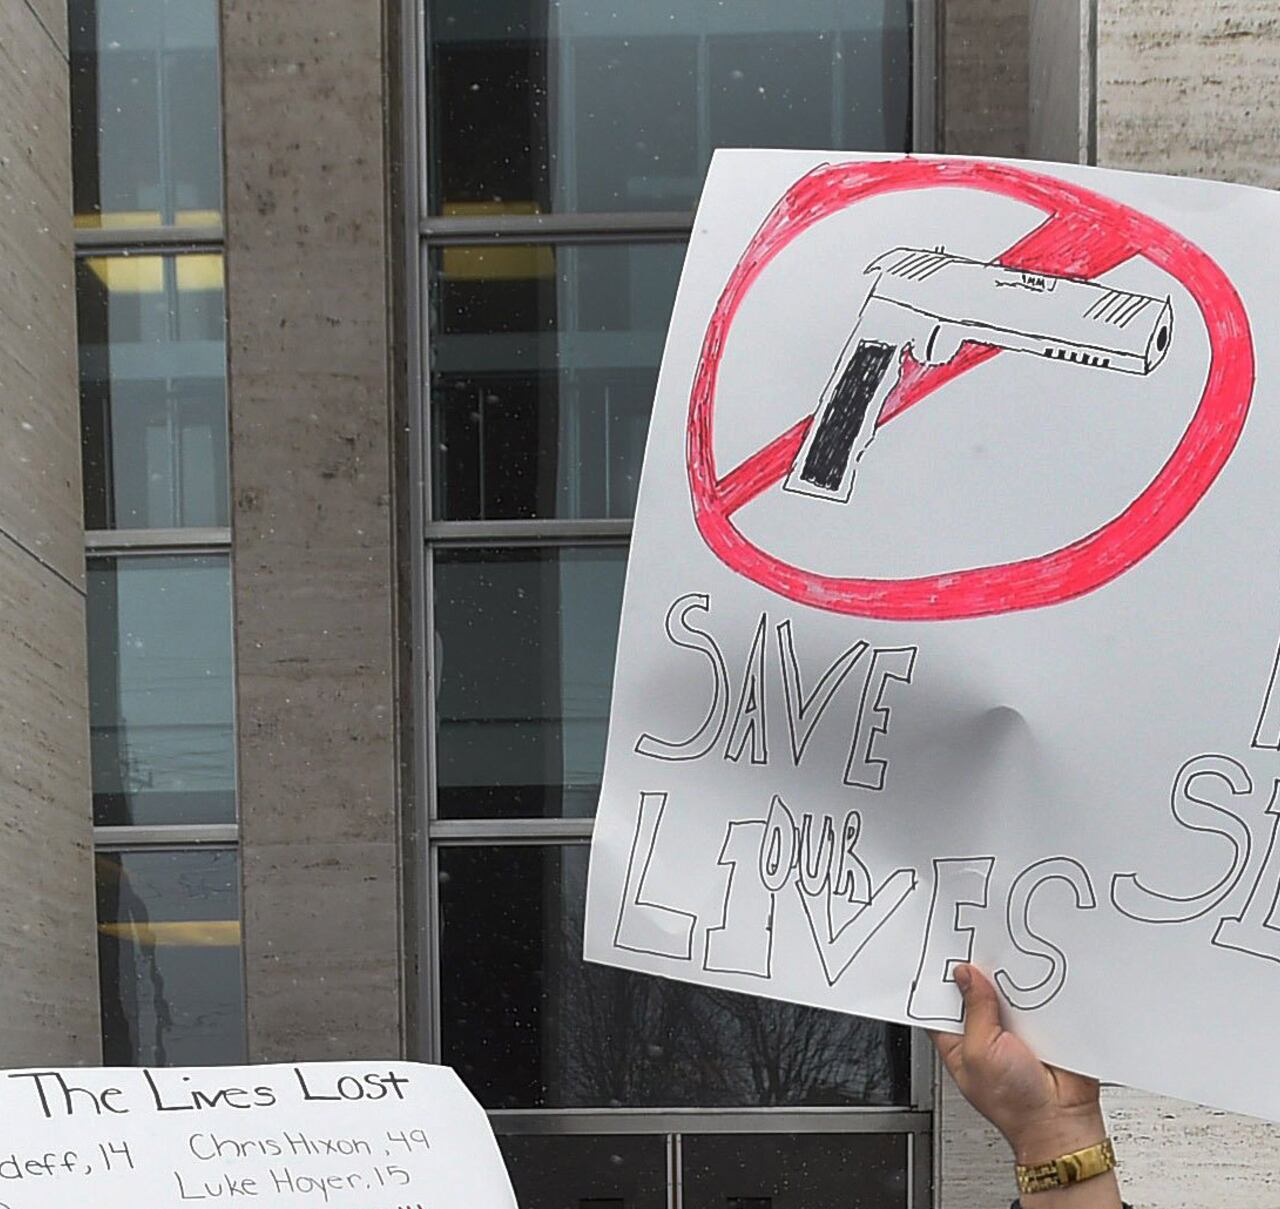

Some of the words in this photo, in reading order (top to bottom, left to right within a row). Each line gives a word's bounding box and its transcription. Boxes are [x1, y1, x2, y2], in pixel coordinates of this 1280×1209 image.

[634, 593, 918, 790] SAVE
[759, 794, 873, 906] OUR
[613, 791, 1097, 1023] LIVES
[8, 1071, 129, 1118] The
[143, 1068, 277, 1112] Lives
[173, 1170, 260, 1201] Luke
[189, 1132, 283, 1162] Chris
